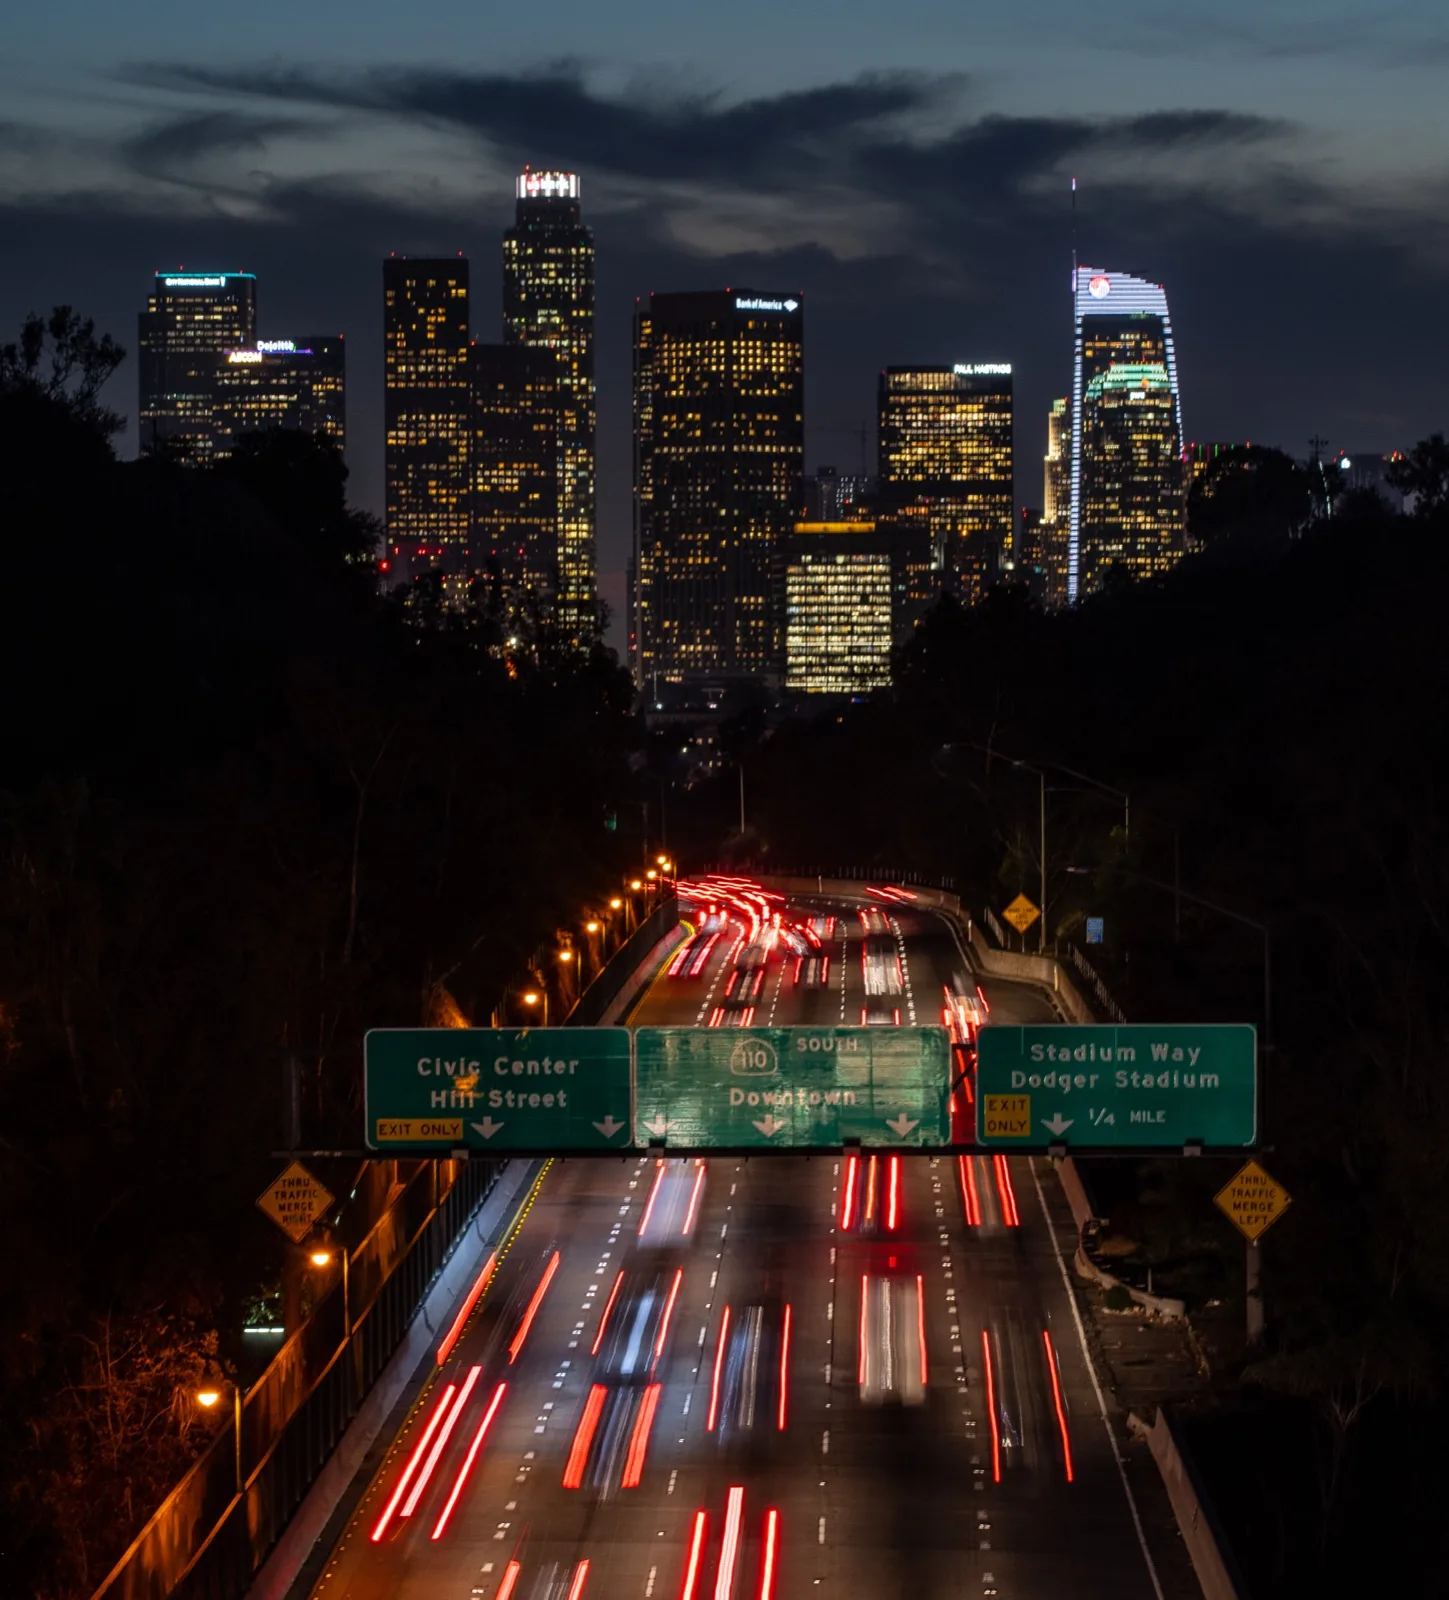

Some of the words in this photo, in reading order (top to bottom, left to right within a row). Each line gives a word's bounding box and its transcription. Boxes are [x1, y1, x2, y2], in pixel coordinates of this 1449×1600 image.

[796, 1037, 858, 1052] SOUTH
[742, 1050, 767, 1069] 110
[1030, 1043, 1136, 1062] Stadium
[1150, 1043, 1201, 1066] Way
[417, 1057, 480, 1076] Civic
[494, 1056, 580, 1076] Center
[1011, 1070, 1099, 1094] Dodger
[1115, 1070, 1219, 1089] Stadium
[430, 1090, 475, 1109] Hill
[488, 1089, 567, 1109] Street
[729, 1087, 856, 1106] Downtown
[988, 1099, 1026, 1112] EXIT
[1130, 1110, 1166, 1123] MILE
[378, 1123, 411, 1136] EXIT
[420, 1123, 460, 1136] ONLY
[988, 1119, 1027, 1132] ONLY
[282, 1178, 310, 1188] THRU
[1240, 1176, 1267, 1185] THRU
[274, 1189, 318, 1200] TRAFFIC
[1231, 1188, 1276, 1198] TRAFFIC
[278, 1202, 314, 1212] MERGE
[1233, 1202, 1274, 1212] MERGE
[1239, 1216, 1268, 1225] LEFT
